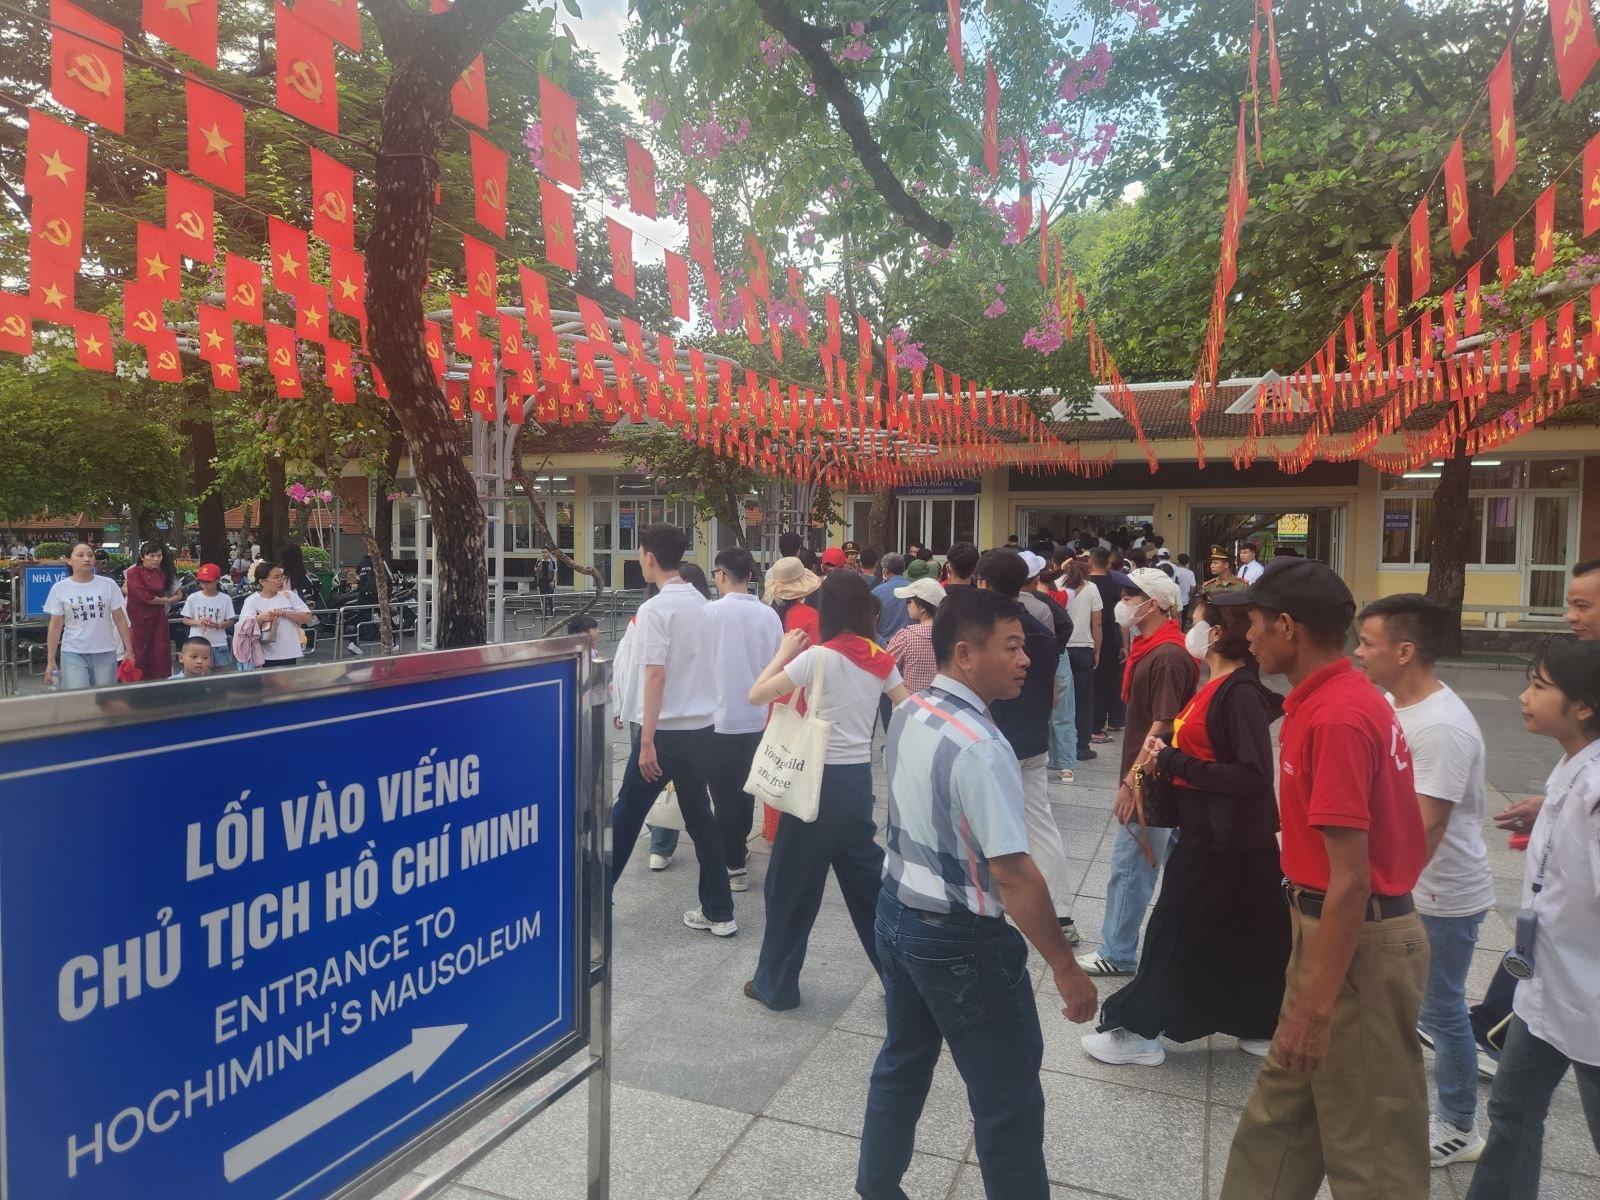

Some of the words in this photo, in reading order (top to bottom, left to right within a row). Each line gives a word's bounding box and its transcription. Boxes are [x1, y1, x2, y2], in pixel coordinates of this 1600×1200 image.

[32, 571, 52, 583] NHÀ
[186, 789, 265, 882] LỐI
[281, 780, 366, 852] VÀO
[378, 747, 480, 823] VIẾNG
[770, 776, 792, 789] free
[58, 906, 181, 1022] CHỦ
[200, 880, 310, 970] TỊCH
[325, 840, 379, 923] HỒ
[392, 823, 451, 895] CHÍ
[461, 803, 539, 871] MINH
[215, 925, 409, 1044] ENTRANCE
[415, 906, 456, 947] TO
[67, 1000, 363, 1178] HOCHIMINH'S
[371, 910, 542, 1022] MAUSOLEUM
